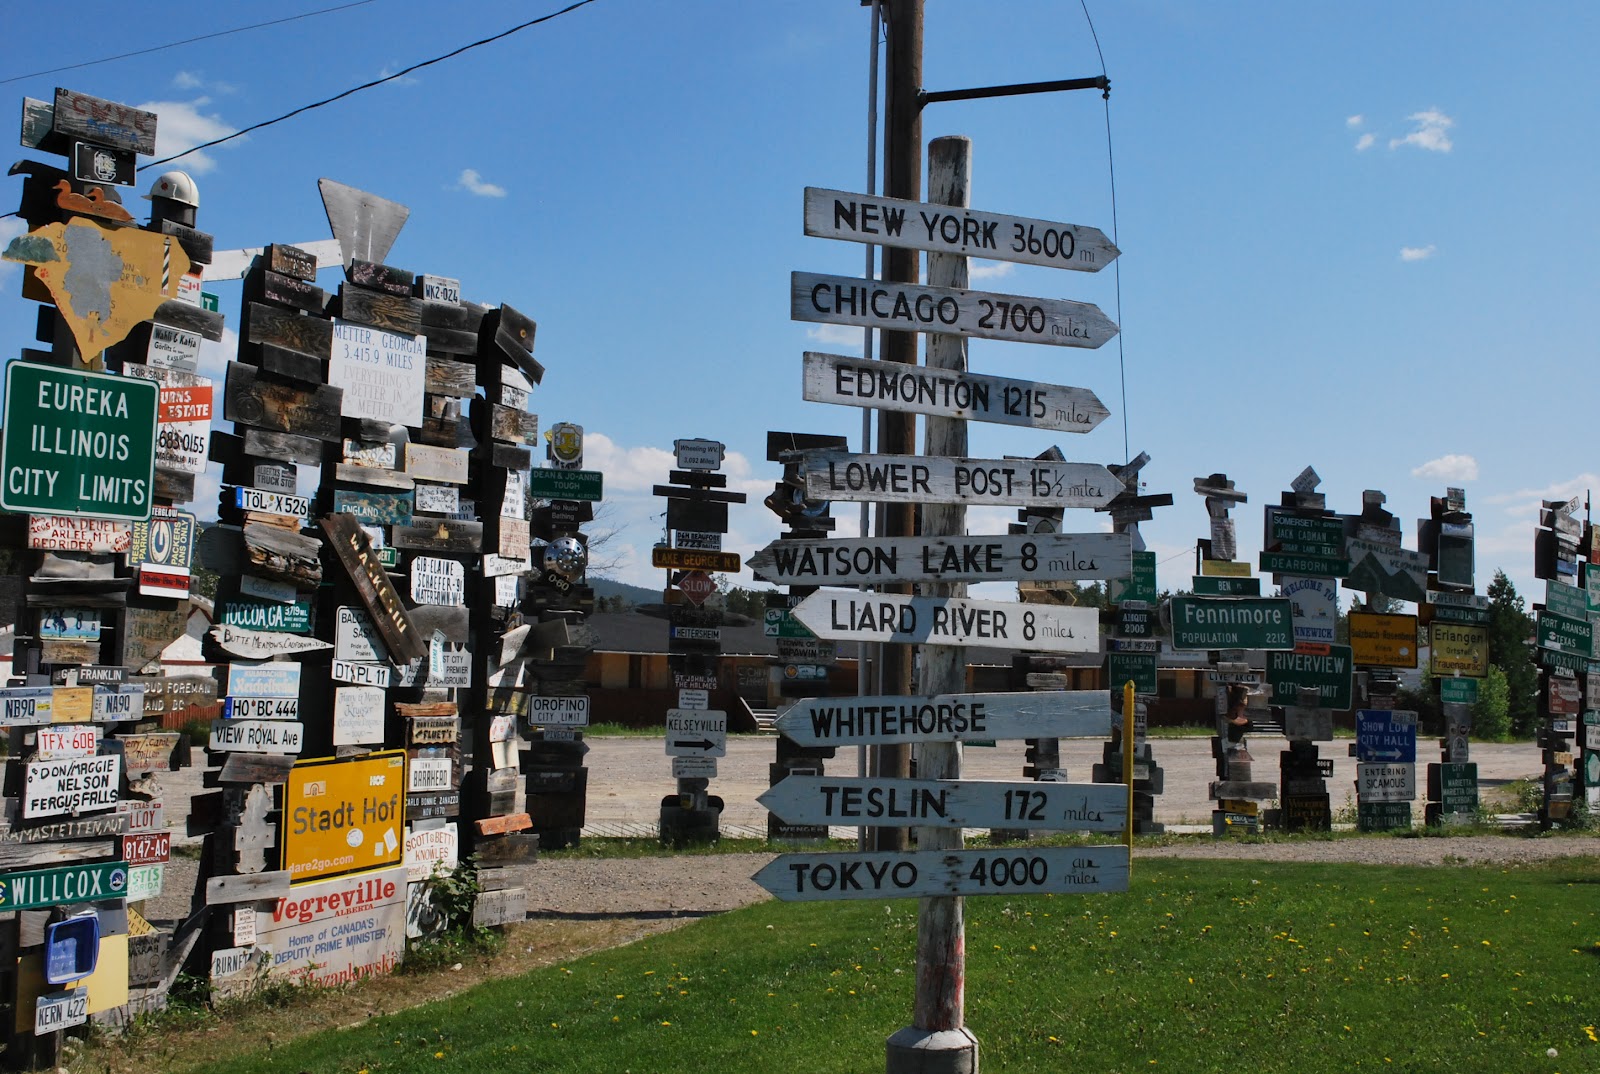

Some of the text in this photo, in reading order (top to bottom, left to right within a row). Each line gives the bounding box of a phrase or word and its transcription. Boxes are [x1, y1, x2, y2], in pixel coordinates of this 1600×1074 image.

[834, 199, 1075, 260] NEW YORK 3600
[811, 283, 1091, 340] CHICAGO 2700 miles
[382, 334, 423, 355] GEORGIA
[385, 353, 413, 371] MILES
[131, 367, 145, 378] FOR
[351, 381, 402, 402] BETTER IN
[835, 364, 1092, 426] EDMONTON 1215 miles
[38, 381, 129, 419] EUREKA
[168, 404, 209, 419] ESTATE
[358, 398, 394, 419] METTER
[31, 425, 130, 461] ILLINOIS
[257, 474, 296, 488] TRUCK STOP
[533, 471, 557, 479] DEAN
[558, 471, 563, 479] &
[828, 461, 1104, 498] LOWER POST miles
[9, 466, 146, 505] CITY LIMITS
[554, 481, 580, 490] TOUGH
[341, 505, 379, 517] ENGLAND
[552, 512, 575, 521] Bathing
[51, 516, 76, 531] DON
[1274, 516, 1313, 528] SOMERSET
[1277, 528, 1294, 539] JACK
[170, 521, 181, 566] PACKERS
[1321, 546, 1337, 555] TEXAS
[655, 553, 719, 566] LAKE GEORGE
[773, 542, 1099, 577] WATSON LAKE 8 miles
[1271, 558, 1328, 571] DEARBORN
[684, 580, 711, 592] SLOW
[1218, 580, 1231, 591] BEN
[1284, 578, 1322, 597] WELCOME
[831, 599, 1075, 642] LIARD RIVER 8 miles
[1185, 604, 1282, 624] Fennimore
[676, 628, 719, 639] HEITERSHEIM
[1541, 616, 1590, 638] PORT ARANSAS
[1182, 632, 1287, 644] POPULATION 2212
[1435, 628, 1484, 644] Erlangen
[1556, 635, 1577, 648] TEXAS
[1274, 652, 1345, 674] RIVERVIEW
[1433, 656, 1486, 671] Frauenaurach
[1542, 651, 1588, 672] Knoxville
[80, 669, 122, 682] FRANKLIN
[446, 666, 468, 674] PREMIER
[167, 682, 211, 695] FOREMAN
[1278, 682, 1300, 695] CITY
[276, 701, 297, 717] 444
[534, 699, 586, 711] OROFINO
[538, 712, 580, 722] CITY LIMIT
[809, 702, 987, 738] WHITEHORSE
[668, 719, 724, 732] KELSEYVILLE
[1362, 722, 1410, 733] SHOW LOW
[216, 726, 298, 746] VIEW ROYAL Ave
[1361, 735, 1410, 747] CITY HALL
[1365, 768, 1407, 776] ENTERING
[57, 775, 110, 793] NELSON
[1366, 778, 1406, 790] SICAMOUS
[31, 792, 80, 812] FERGUS
[130, 801, 150, 811] TEXAS
[820, 786, 1105, 823] TESLIN 172 miles
[293, 794, 398, 835] Stadt Hof
[125, 838, 169, 862] 8147-AC
[415, 847, 449, 862] KNOWLES
[289, 853, 354, 875] dare2go.com
[790, 857, 1049, 893] TOKYO 4000
[12, 869, 103, 905] WILLCOX
[272, 878, 396, 923] Vegreville
[334, 903, 375, 918] ALBERTA
[288, 918, 375, 948] Home of CANADA'S
[274, 928, 387, 965] DEPUTY PRIME MINISTER
[38, 998, 85, 1027] KERN 422
